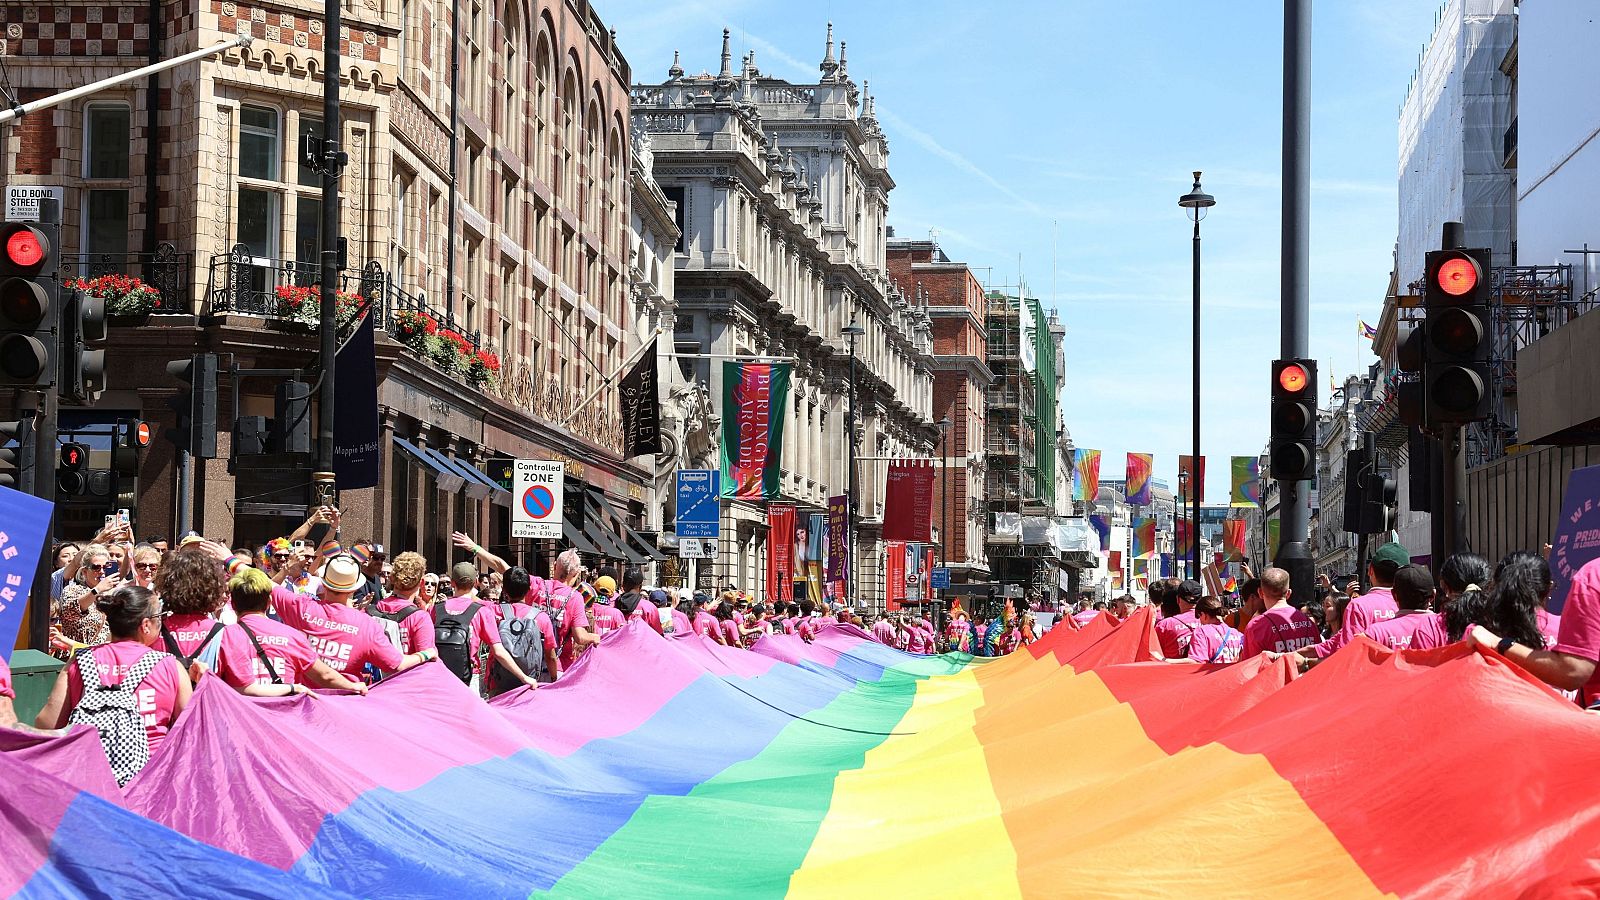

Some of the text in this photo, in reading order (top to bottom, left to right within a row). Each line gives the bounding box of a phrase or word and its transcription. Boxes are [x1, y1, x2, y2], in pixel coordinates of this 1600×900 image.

[11, 189, 53, 198] OLD BOND
[11, 198, 40, 207] STREET
[640, 369, 655, 446] BENTLEY
[626, 387, 639, 451] & SKINNER
[740, 399, 753, 468] ARCADE
[752, 374, 770, 490] BURLINGTON
[334, 444, 358, 457] Mappin
[517, 462, 561, 472] Controlled
[523, 473, 554, 483] ZONE
[1570, 499, 1592, 524] WE
[1574, 529, 1600, 542] PR!D
[1374, 609, 1396, 619] FLAG
[303, 612, 359, 636] FLAG BEARER
[178, 630, 211, 642] BEAR
[250, 635, 289, 646] EARER
[308, 634, 353, 661] R!DE
